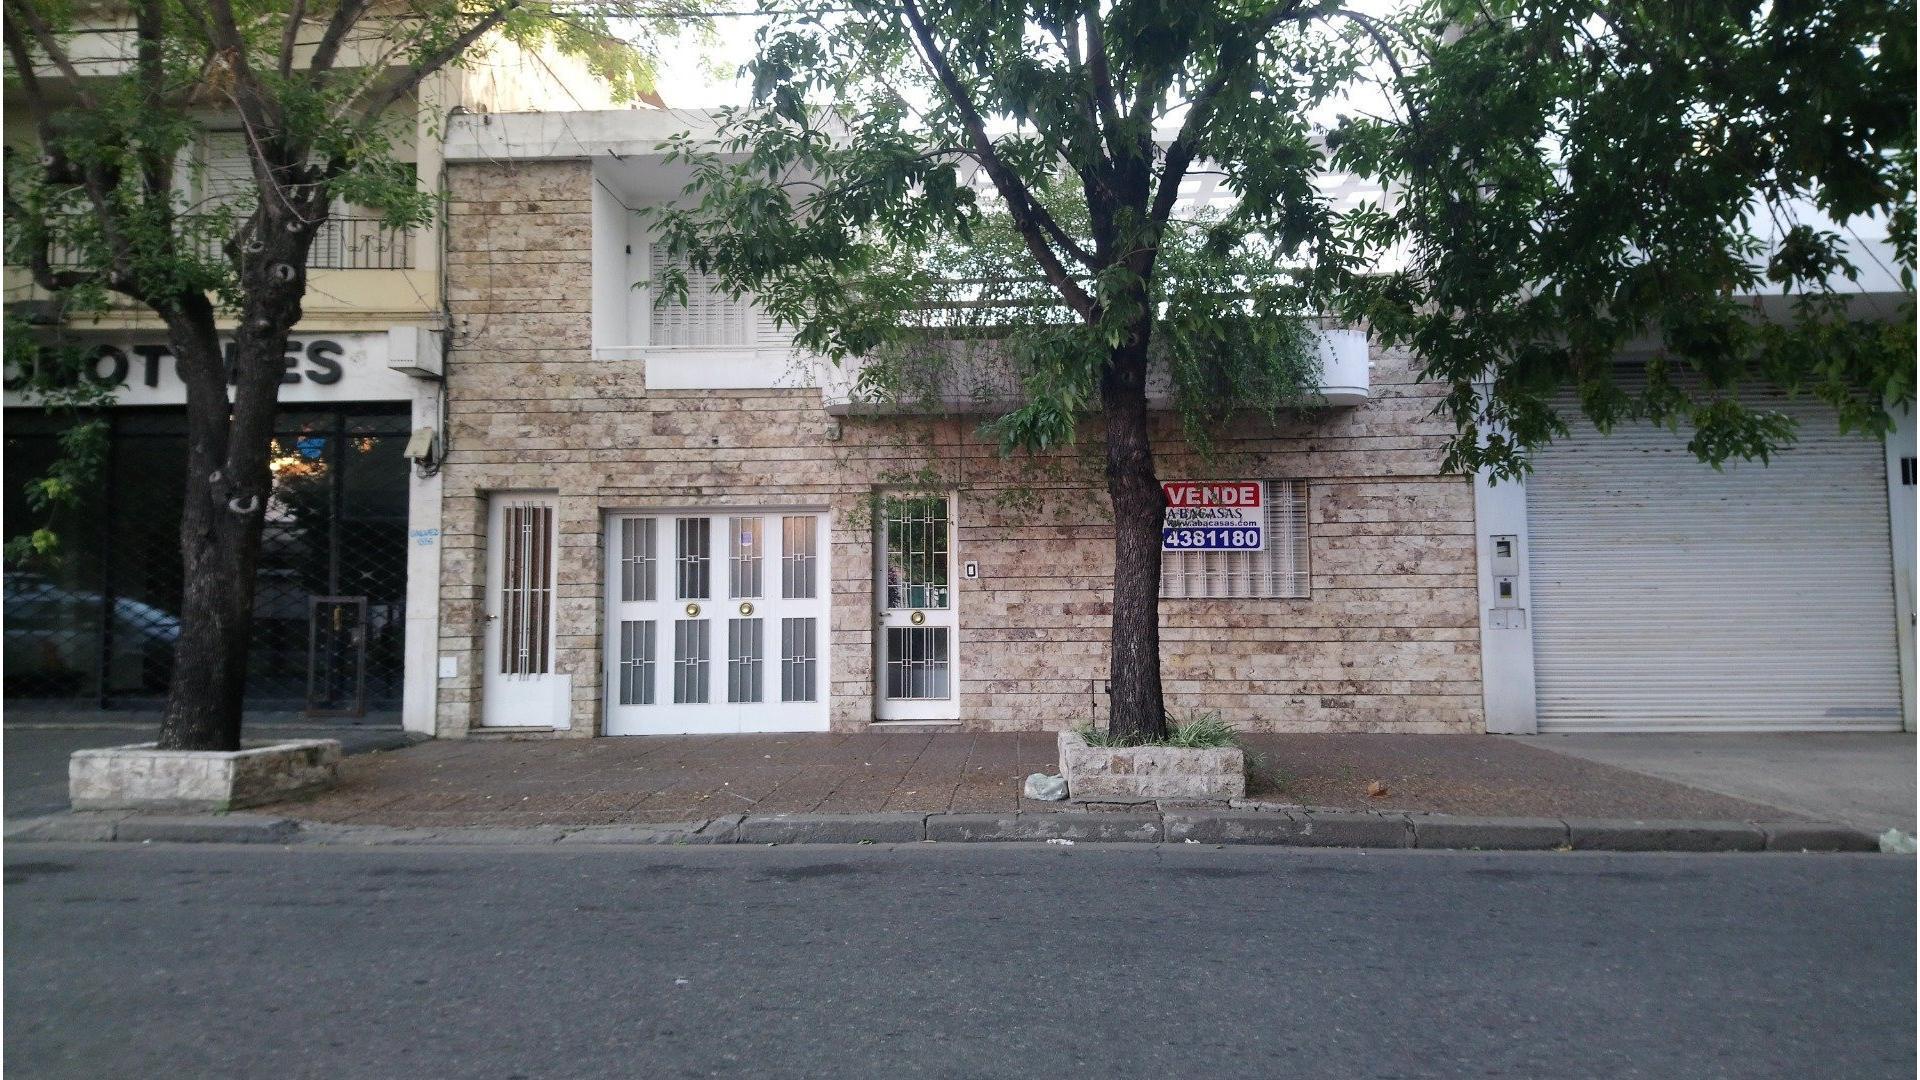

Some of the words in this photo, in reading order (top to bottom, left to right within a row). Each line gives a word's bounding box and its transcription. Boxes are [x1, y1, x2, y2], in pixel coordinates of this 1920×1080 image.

[1167, 486, 1255, 505] VENDE
[1167, 508, 1243, 519] ABACASAS
[1166, 530, 1258, 546] 4381180
